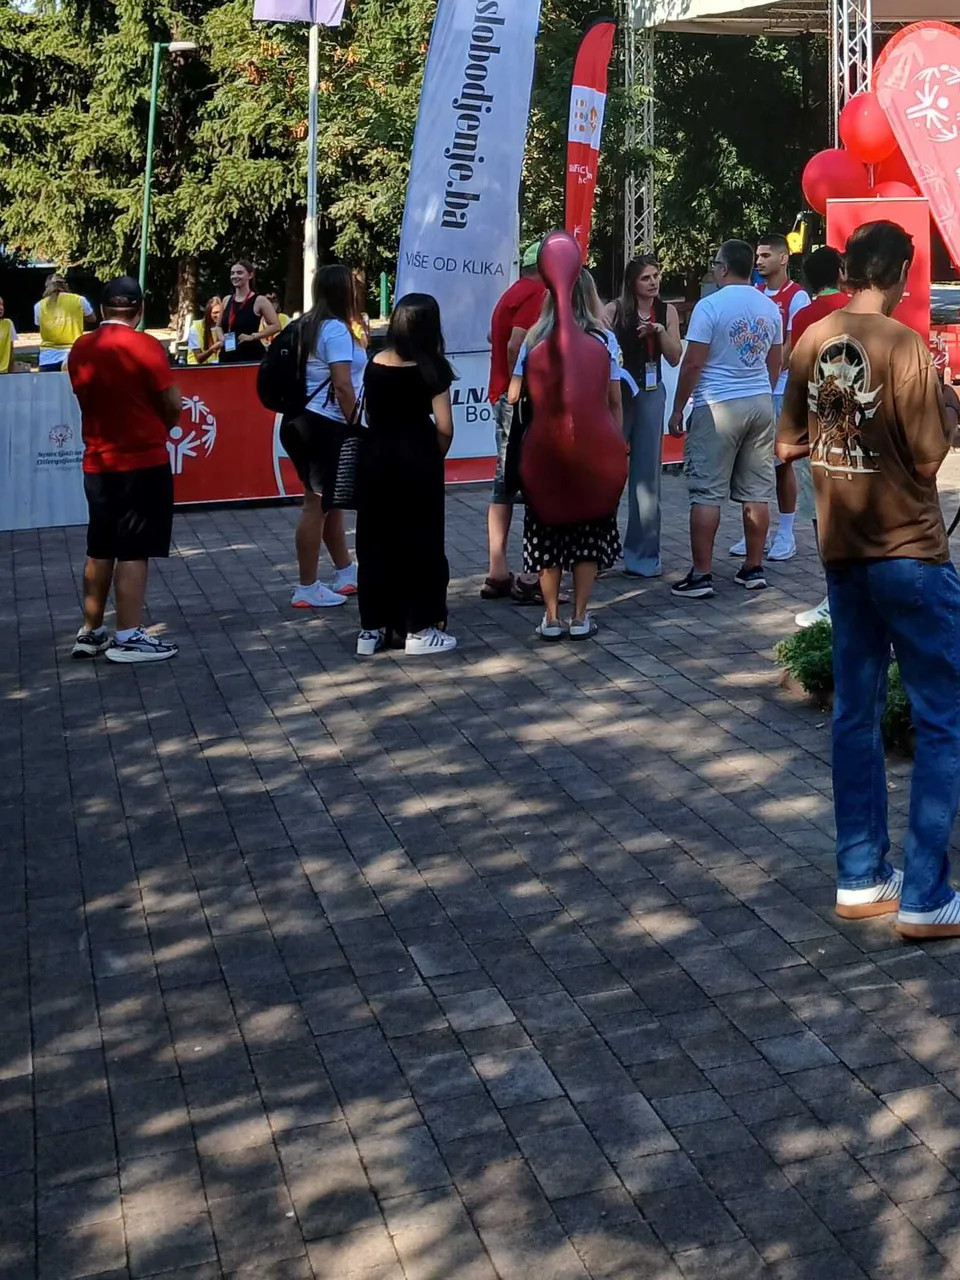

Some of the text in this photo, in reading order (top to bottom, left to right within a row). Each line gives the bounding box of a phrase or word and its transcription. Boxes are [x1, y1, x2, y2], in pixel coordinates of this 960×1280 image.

[405, 251, 505, 277] VIŠE OD KLIKA
[466, 405, 495, 422] Bo
